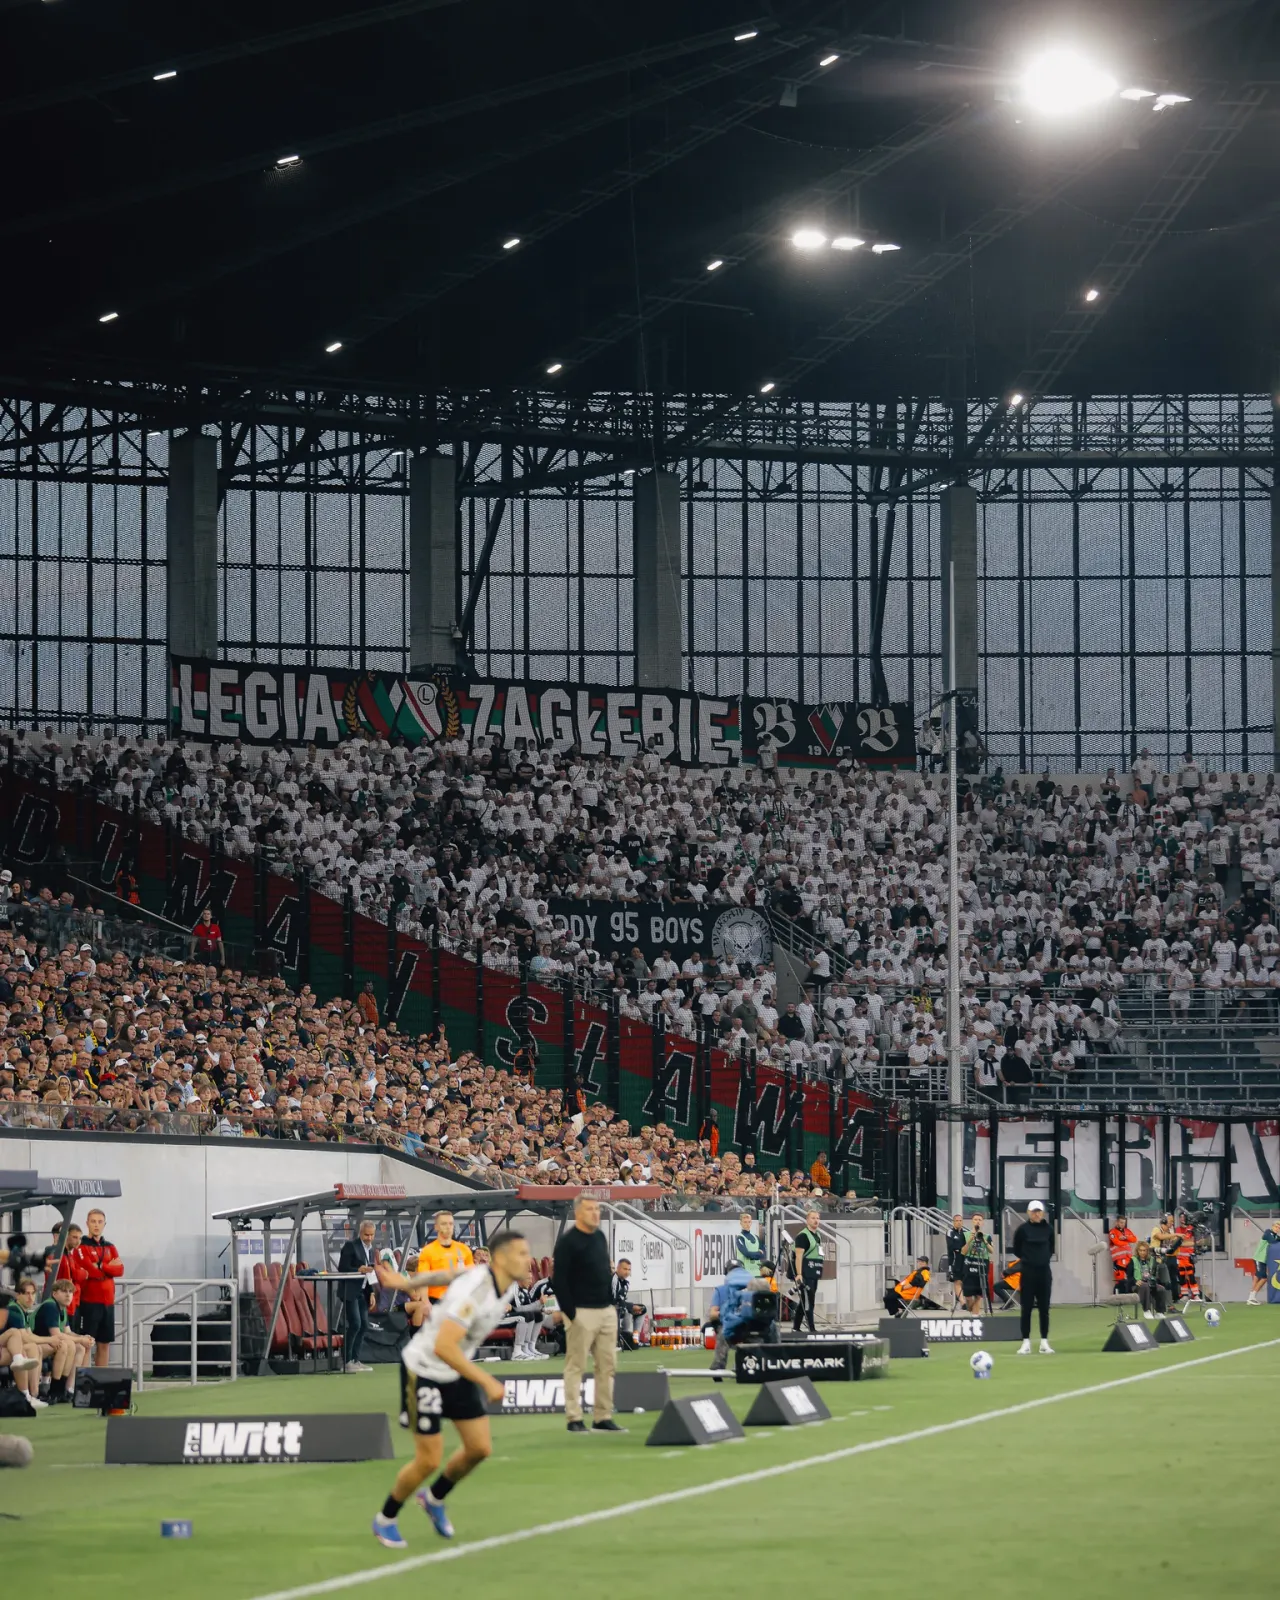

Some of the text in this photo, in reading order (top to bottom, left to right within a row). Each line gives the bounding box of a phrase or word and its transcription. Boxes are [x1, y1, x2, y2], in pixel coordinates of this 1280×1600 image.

[179, 663, 339, 742] LEGIA
[548, 911, 704, 944] DDY 95 BOYS
[1202, 1202, 1214, 1212] 24
[928, 1319, 983, 1337] Witt
[767, 1357, 845, 1370] LIVE PARK
[200, 1421, 303, 1456] Witt
